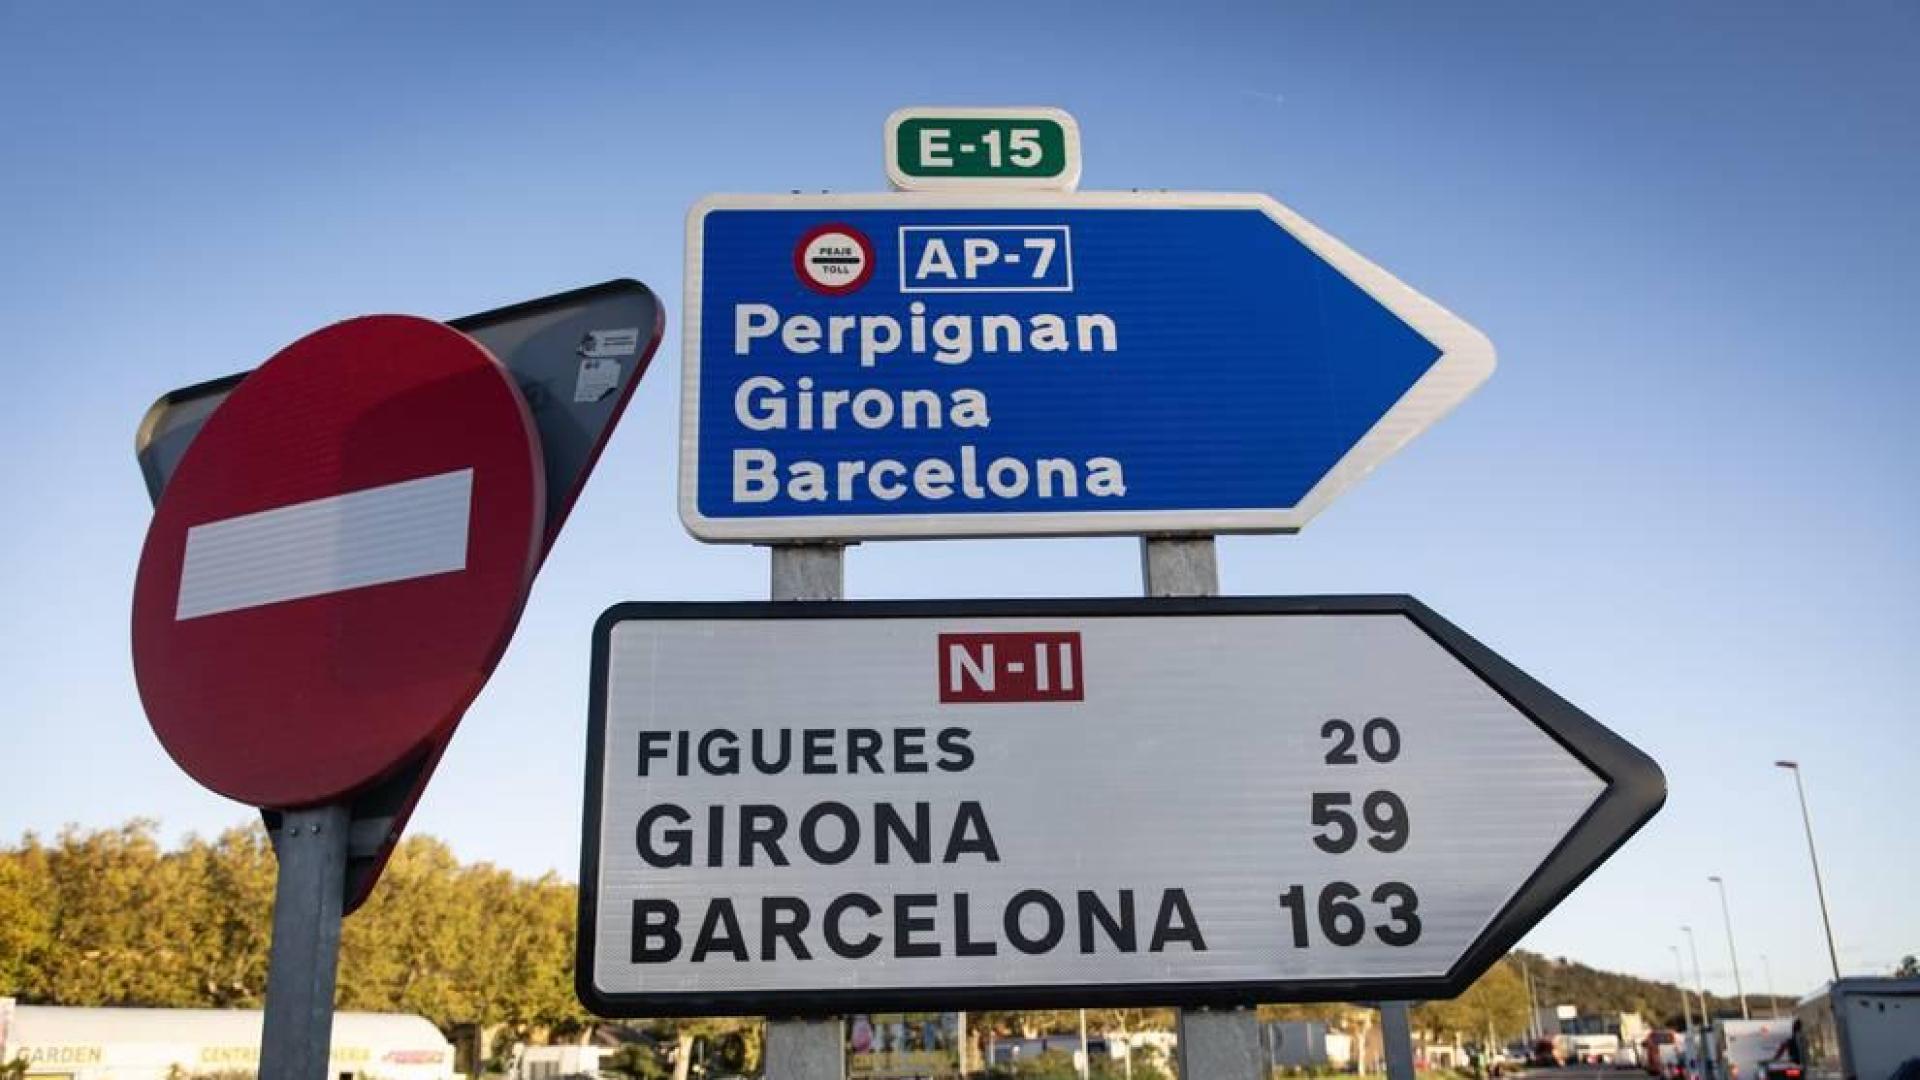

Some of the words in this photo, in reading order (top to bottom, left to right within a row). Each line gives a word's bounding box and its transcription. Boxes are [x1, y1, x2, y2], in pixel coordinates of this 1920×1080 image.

[918, 128, 1042, 167] E-15
[819, 246, 853, 255] PEAJE
[822, 264, 851, 274] TOLL
[915, 237, 1057, 281] AP-7
[734, 302, 1119, 367] Perpignan
[734, 376, 991, 431] Girona
[732, 445, 1127, 503] Barcelona
[948, 642, 1073, 692] N-II
[637, 726, 976, 777] FIGUERES
[1320, 717, 1401, 765] 20
[635, 800, 1001, 869] GIRONA
[1311, 790, 1411, 854] 59
[629, 887, 1209, 965] BARCELONA
[1278, 881, 1423, 949] 163
[16, 1046, 102, 1063] GARDEN
